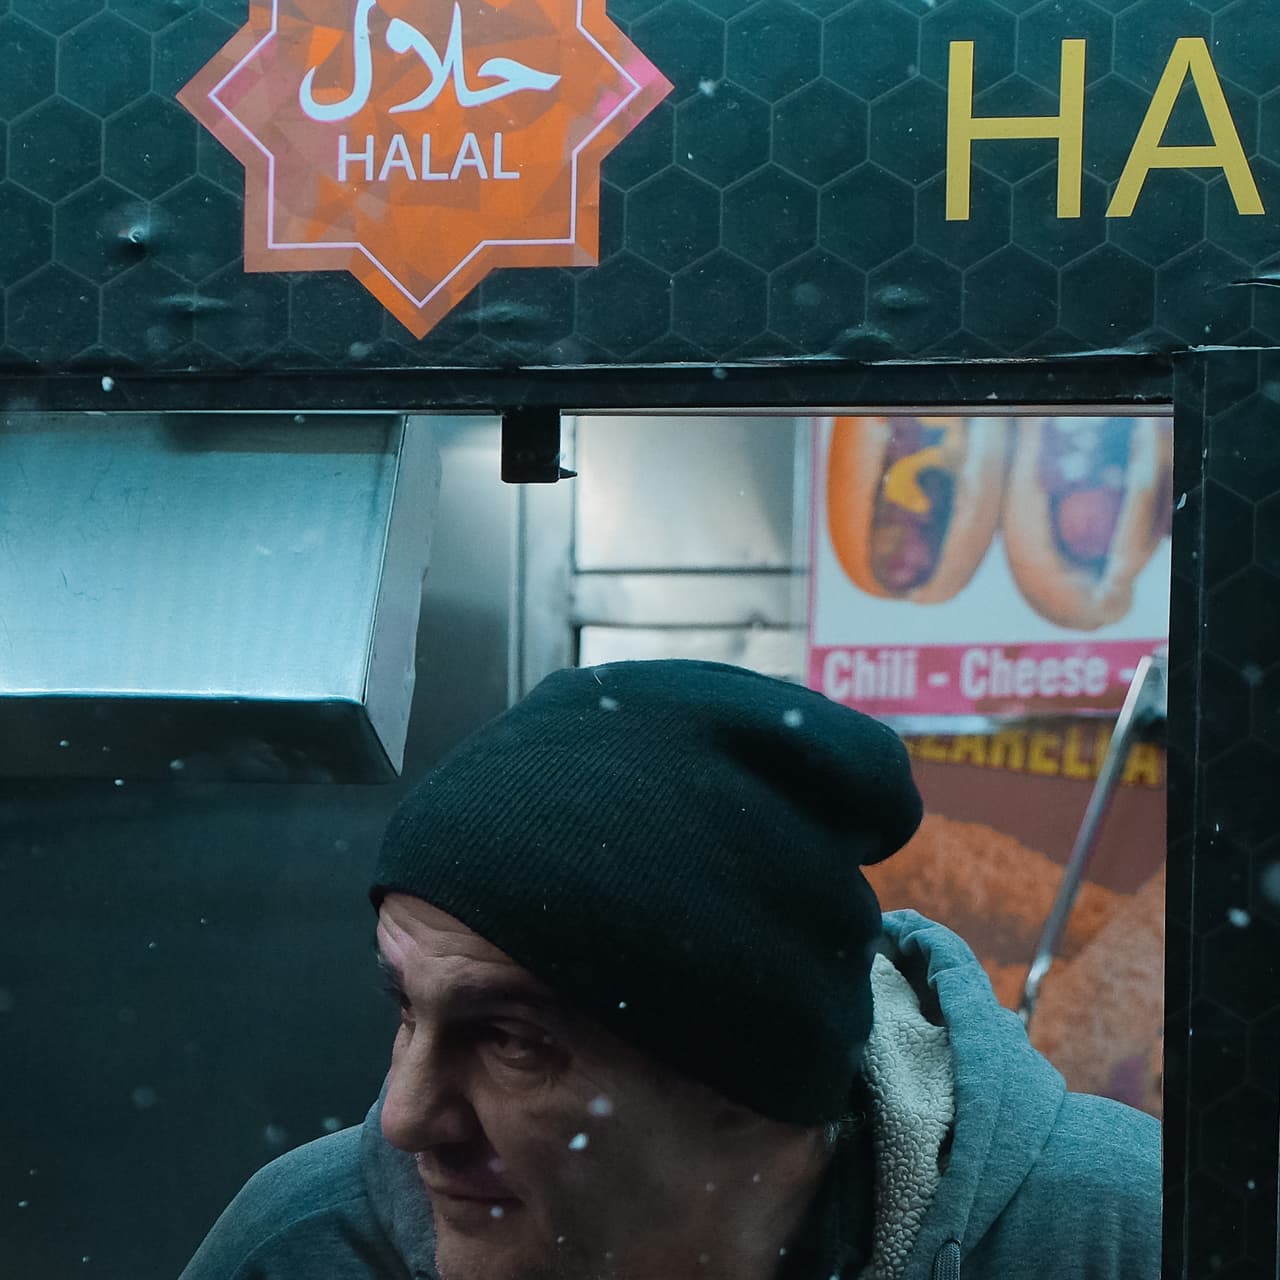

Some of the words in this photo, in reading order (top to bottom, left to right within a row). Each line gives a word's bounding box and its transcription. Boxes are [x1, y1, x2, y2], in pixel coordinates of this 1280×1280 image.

[337, 132, 520, 182] HALAL
[823, 648, 916, 700] Chili
[960, 646, 1108, 698] Cheese
